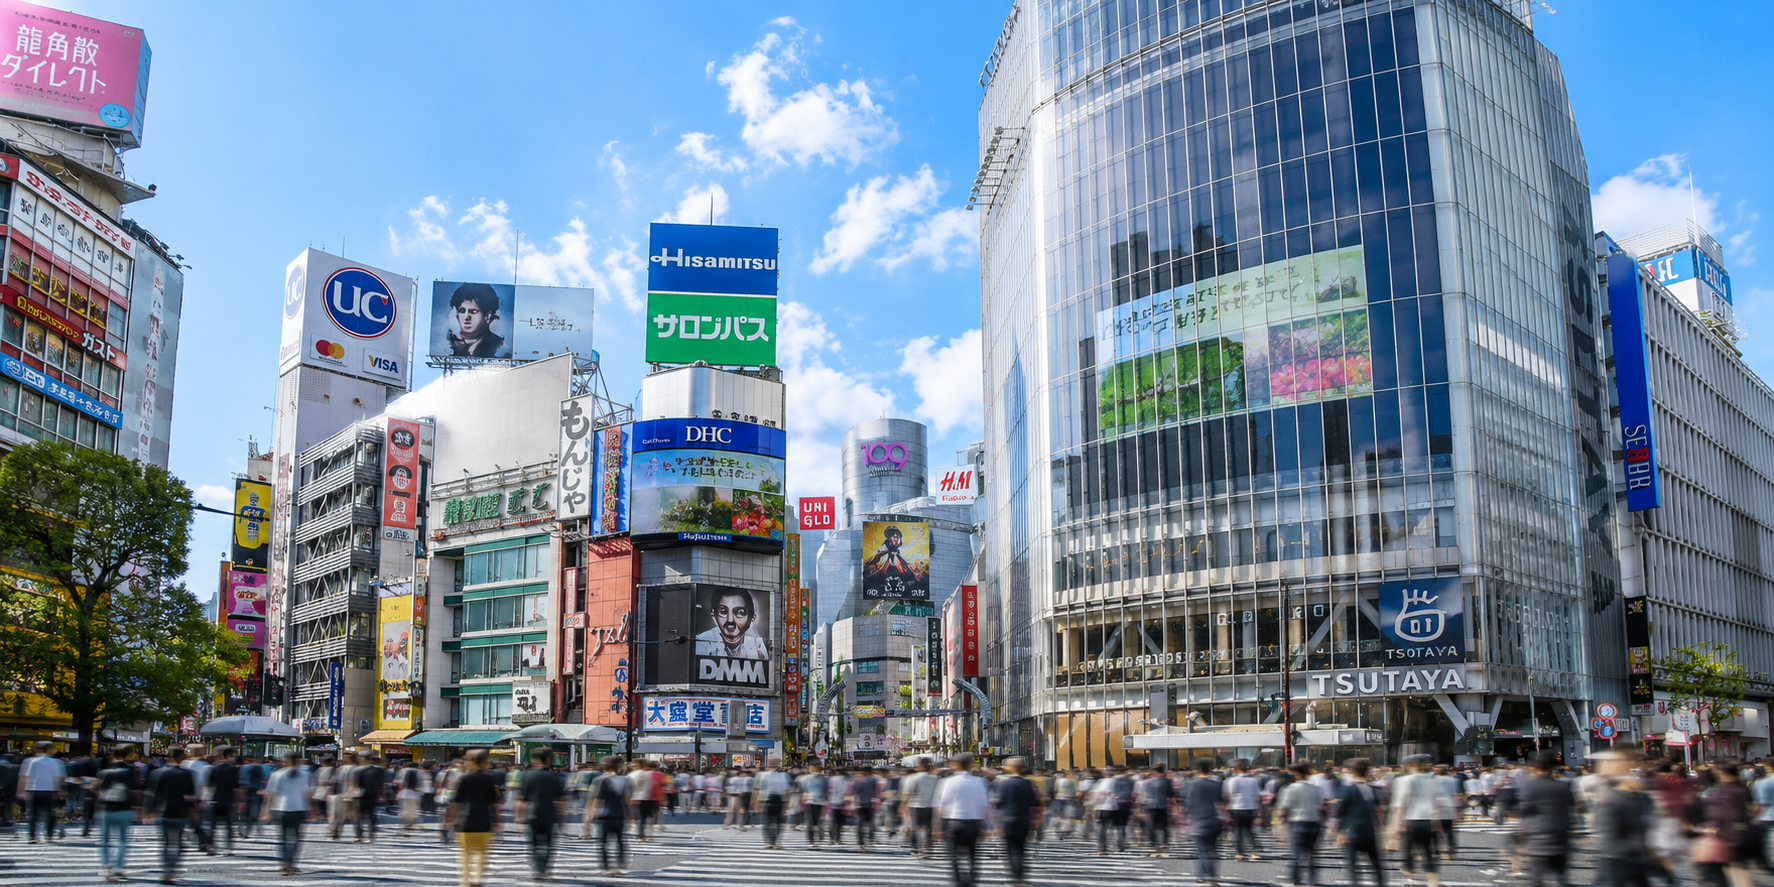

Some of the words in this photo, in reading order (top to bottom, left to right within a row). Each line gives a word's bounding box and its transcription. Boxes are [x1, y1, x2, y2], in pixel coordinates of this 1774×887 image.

[17, 24, 99, 67] 龍角散
[1, 53, 106, 94] ダイレクト
[287, 276, 302, 306] UC
[333, 280, 388, 324] UC
[653, 314, 769, 342] サロンパス
[82, 332, 116, 361] ガスト
[369, 355, 399, 373] VISA
[685, 426, 732, 443] DHC
[861, 442, 908, 470] 109
[804, 502, 827, 513] UNI
[699, 658, 767, 684] DMM
[1312, 668, 1465, 696] TSUTAYA
